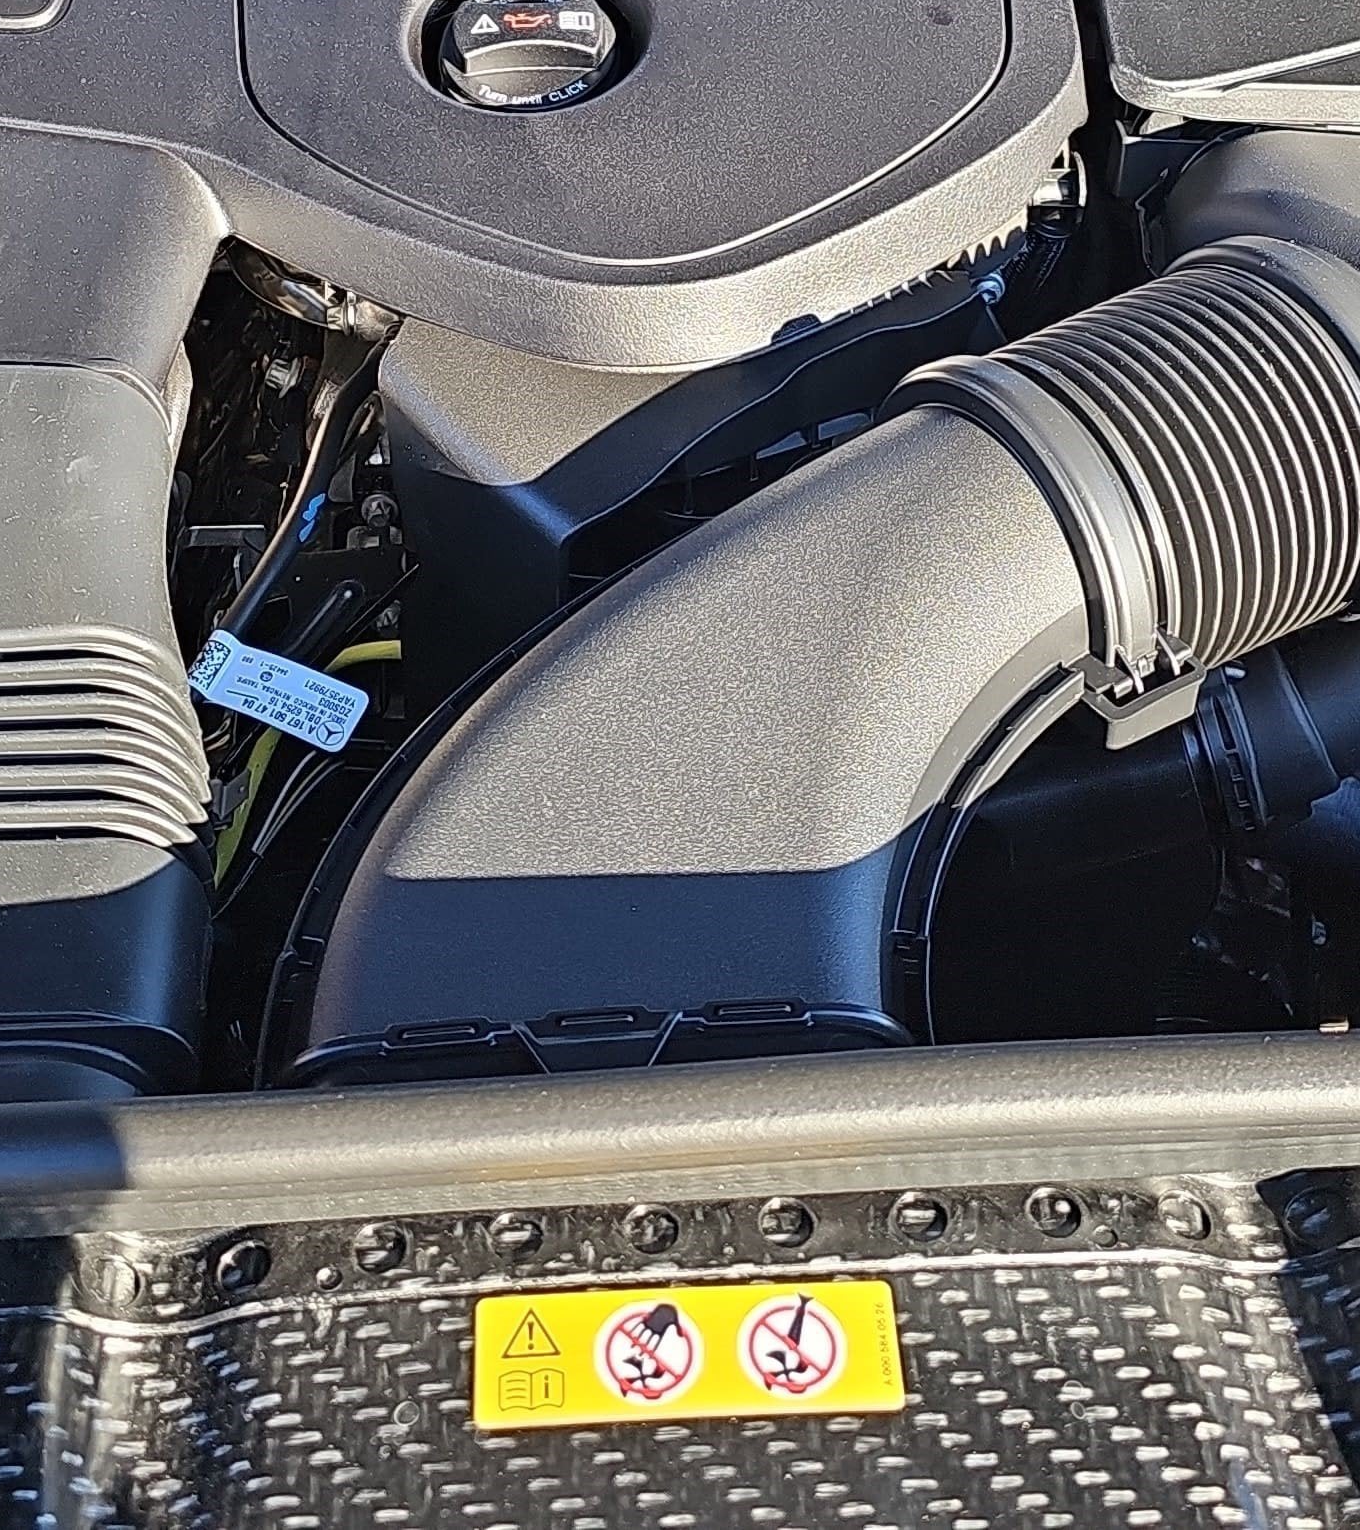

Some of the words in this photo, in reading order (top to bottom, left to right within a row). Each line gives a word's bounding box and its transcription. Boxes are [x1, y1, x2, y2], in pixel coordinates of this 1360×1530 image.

[479, 85, 508, 103] Turn
[549, 80, 588, 101] CLICK
[303, 678, 356, 708] YAP3579921
[241, 697, 255, 709] 04
[254, 701, 268, 714] 47
[267, 695, 302, 717] 6254.16
[317, 696, 352, 718] ZGS003
[268, 707, 287, 722] 501
[302, 710, 321, 725] DBL
[286, 715, 305, 730] 167
[307, 724, 316, 735] A
[881, 1355, 891, 1376] 000
